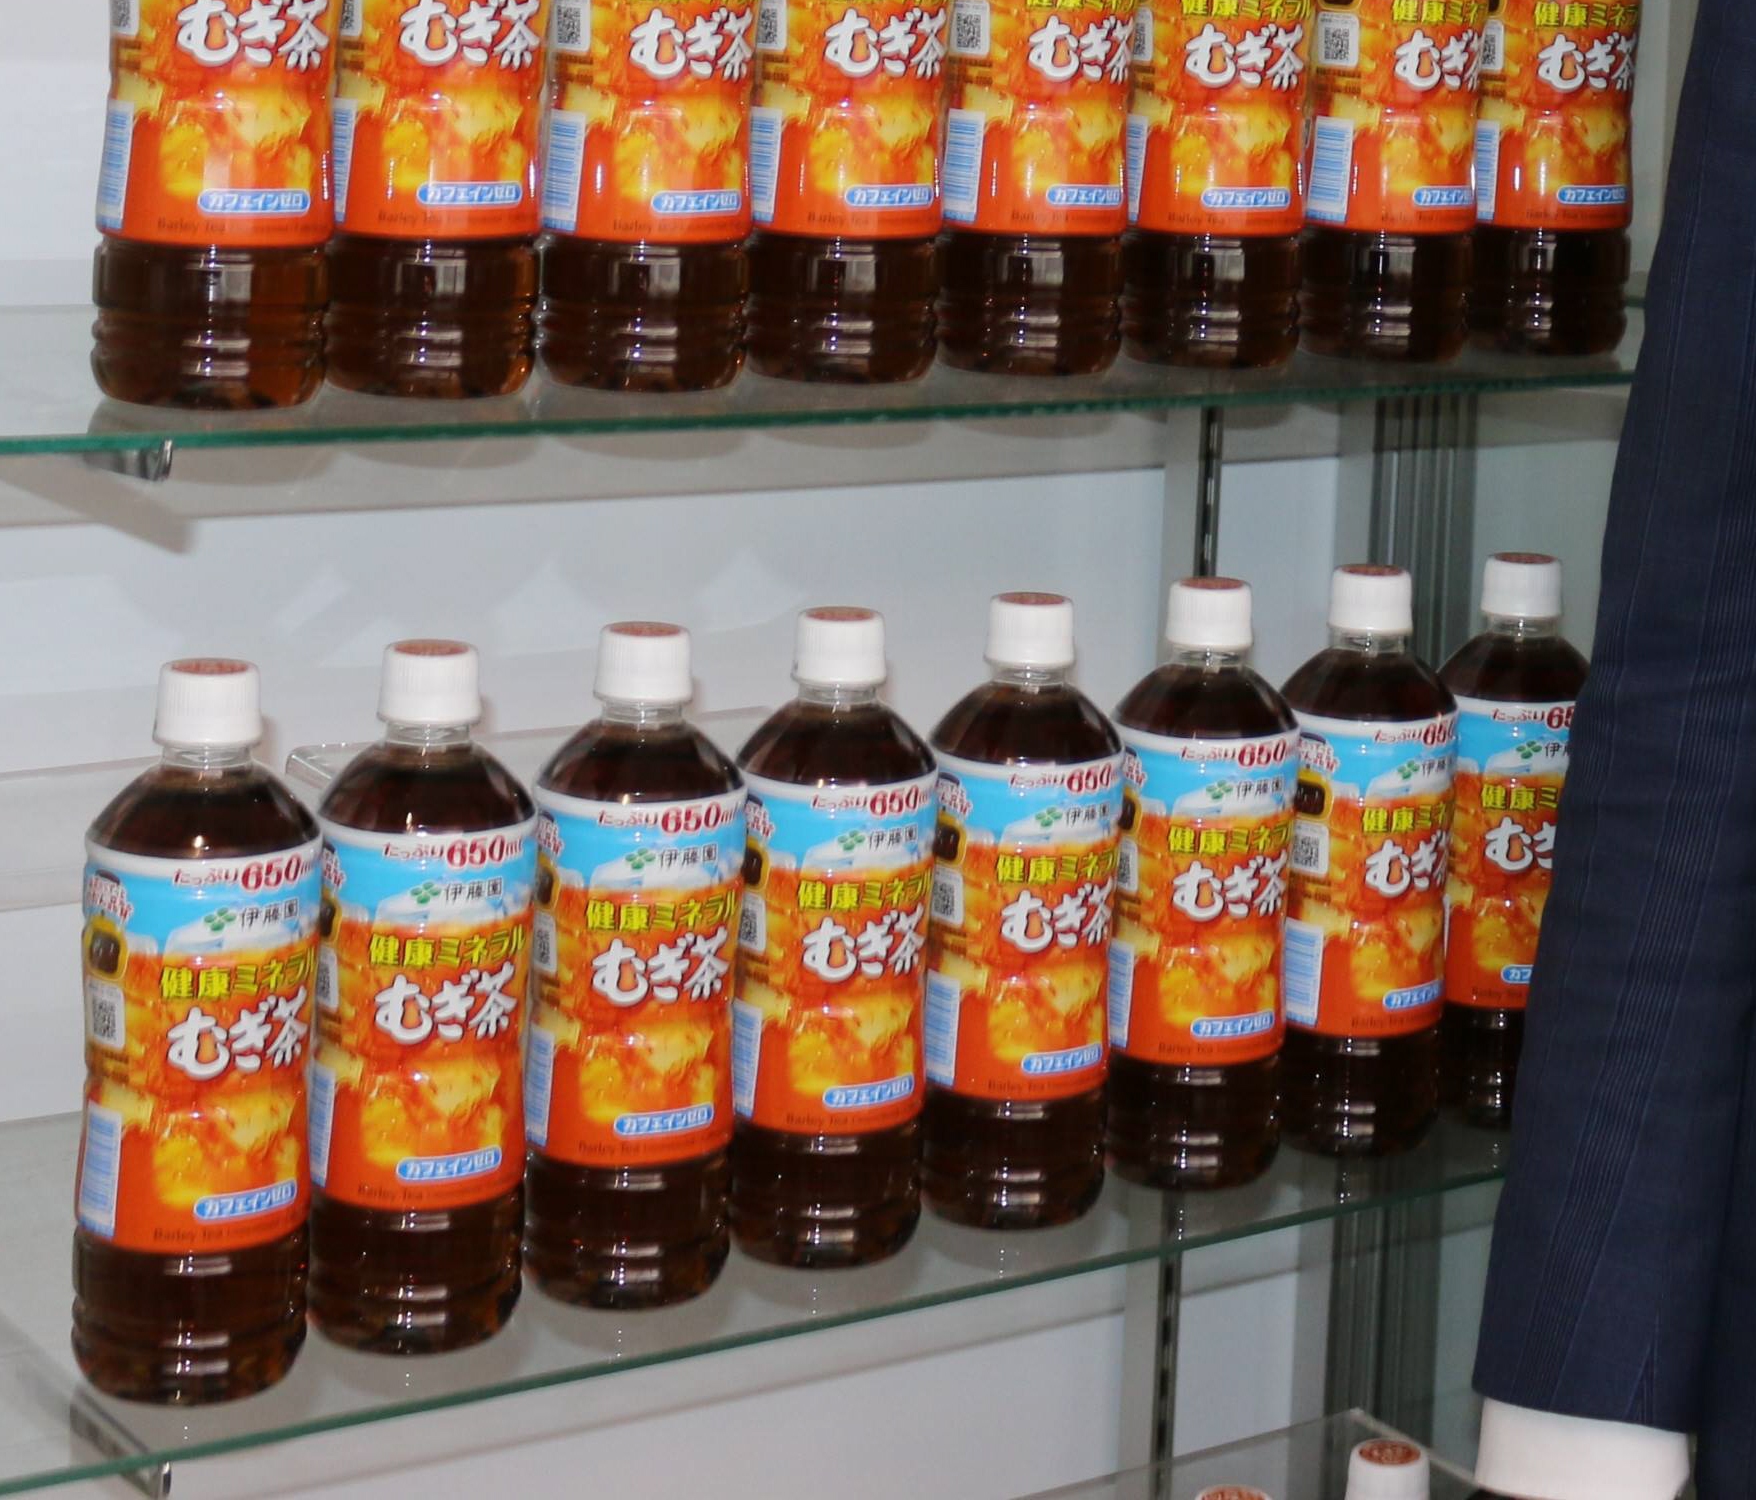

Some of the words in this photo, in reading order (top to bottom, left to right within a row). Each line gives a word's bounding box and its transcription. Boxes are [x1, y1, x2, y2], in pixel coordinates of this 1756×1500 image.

[629, 7, 754, 82] むぎ茶
[824, 7, 946, 79] むぎ茶
[1028, 15, 1133, 85] むぎ茶
[1184, 22, 1304, 91] むぎ茶
[1538, 33, 1636, 92] むぎ茶
[208, 193, 303, 211] カフェインゼロ
[427, 185, 517, 202] カフェインゼロ
[661, 193, 737, 210] カフェインゼロ
[1235, 778, 1284, 800] 伊藤園
[1481, 783, 1558, 811] 健康ミ
[598, 802, 737, 835] たっぷり650ml
[1065, 803, 1110, 828] 伊藤園
[383, 835, 523, 869] たっぷり650ml
[659, 844, 718, 870] 伊藤園
[868, 824, 918, 851] 伊藤園
[443, 877, 503, 903] 伊藤園
[798, 868, 932, 912] 健康ミネラル
[1172, 850, 1287, 922] むぎ茶
[240, 898, 300, 929] 伊藤園
[586, 889, 737, 931] 健康ミネラル
[1001, 877, 1113, 954] むぎ茶
[369, 923, 527, 968] 健康ミネラル
[803, 903, 925, 982] むぎ茶
[160, 946, 315, 1000] 健康ミネラル
[592, 925, 729, 1006] むぎ茶
[375, 961, 516, 1046] むぎ茶
[167, 987, 308, 1082] むぎ茶
[406, 1153, 496, 1178] カフェインゼロ
